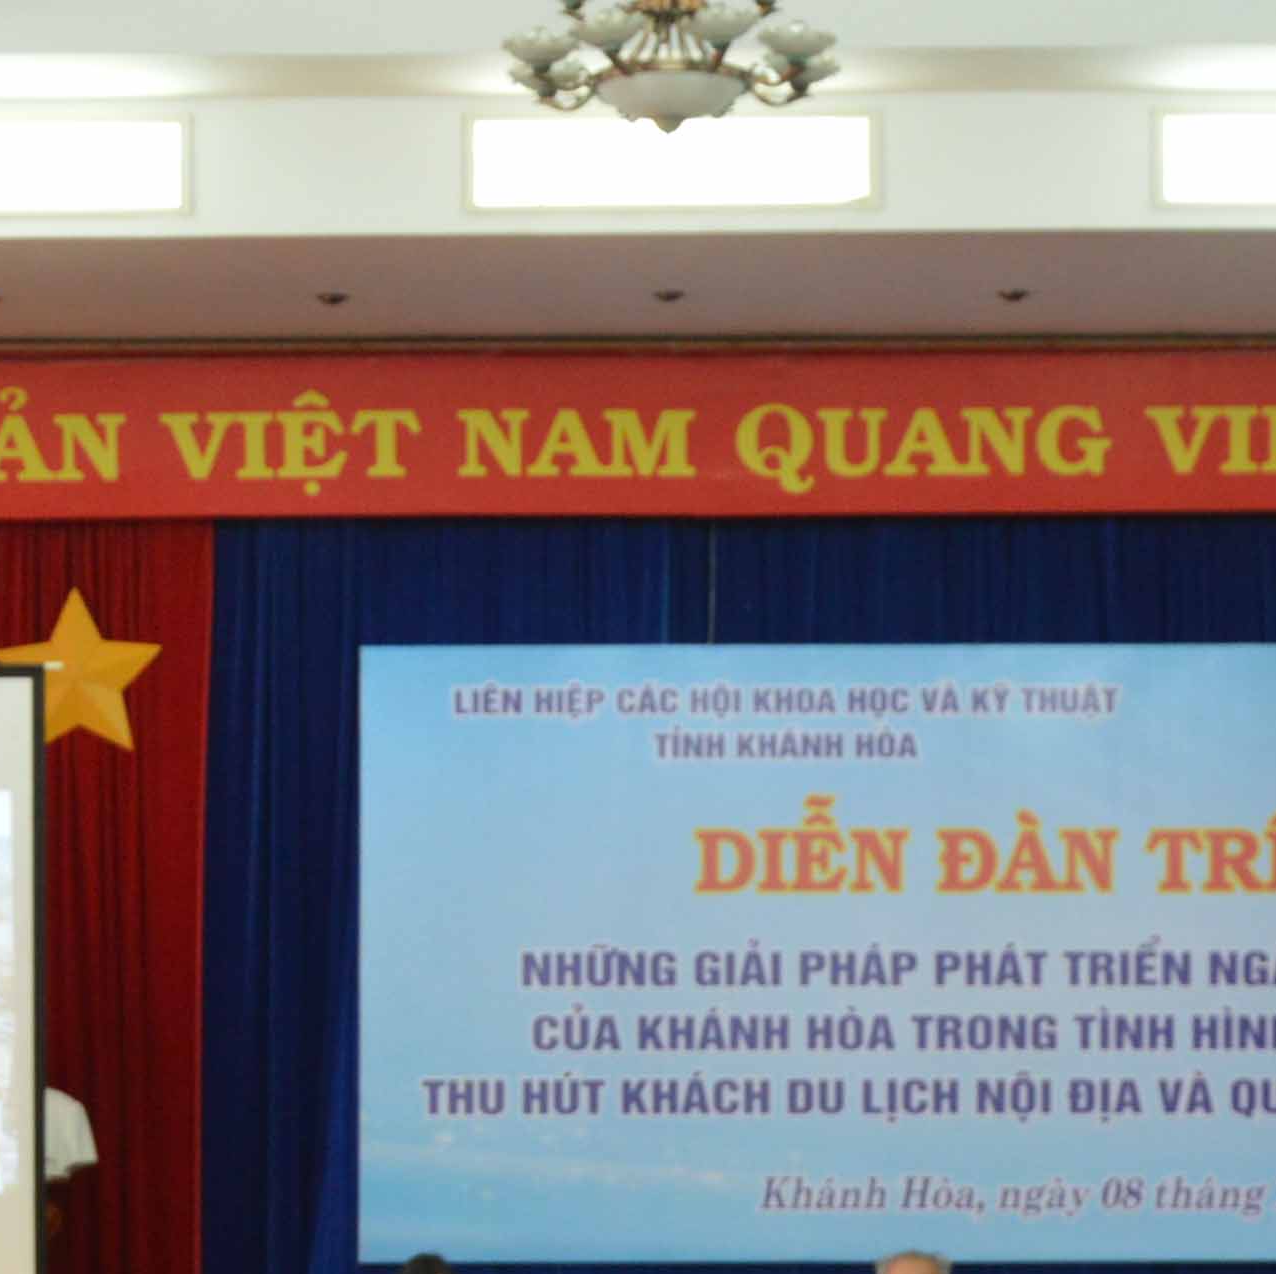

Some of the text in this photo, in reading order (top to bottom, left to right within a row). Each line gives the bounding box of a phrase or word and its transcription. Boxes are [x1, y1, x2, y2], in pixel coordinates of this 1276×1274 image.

[160, 390, 422, 497] VIỆT
[457, 409, 698, 479] NAM
[735, 404, 1114, 495] QUANG
[454, 682, 1119, 719] LIÊN HIỆP CÁC HỘI KHOA HỌC VÀ KỸ THUẬT
[655, 726, 919, 759] TỈNH KHÁNH HÒA
[694, 794, 912, 897] DIỄN
[935, 809, 1122, 897] ĐÀN
[522, 943, 678, 988] NHỮNG
[694, 939, 783, 988] GIẢI
[799, 944, 919, 988] PHÁP
[934, 944, 1049, 988] PHÁT
[1063, 936, 1193, 988] TRIỂN
[532, 1004, 622, 1053] CỦA
[637, 1009, 791, 1052] KHÁNH
[806, 1009, 896, 1052] HÒA
[911, 1015, 1059, 1052] TRONG
[1074, 1009, 1176, 1052] TÌNH
[422, 1079, 506, 1117] THU
[522, 1073, 606, 1116] HÚT
[622, 1073, 772, 1116] KHÁCH
[788, 1079, 846, 1116] DU
[862, 1079, 960, 1124] LỊCH
[977, 1073, 1053, 1123] NỘI
[1069, 1079, 1144, 1123] ĐỊA
[1159, 1071, 1215, 1116] VÀ
[760, 1177, 888, 1212] Khánh
[900, 1177, 988, 1217] Hòa,
[999, 1178, 1091, 1218] ngày
[1100, 1179, 1146, 1211] 08
[1155, 1177, 1268, 1218] tháng
